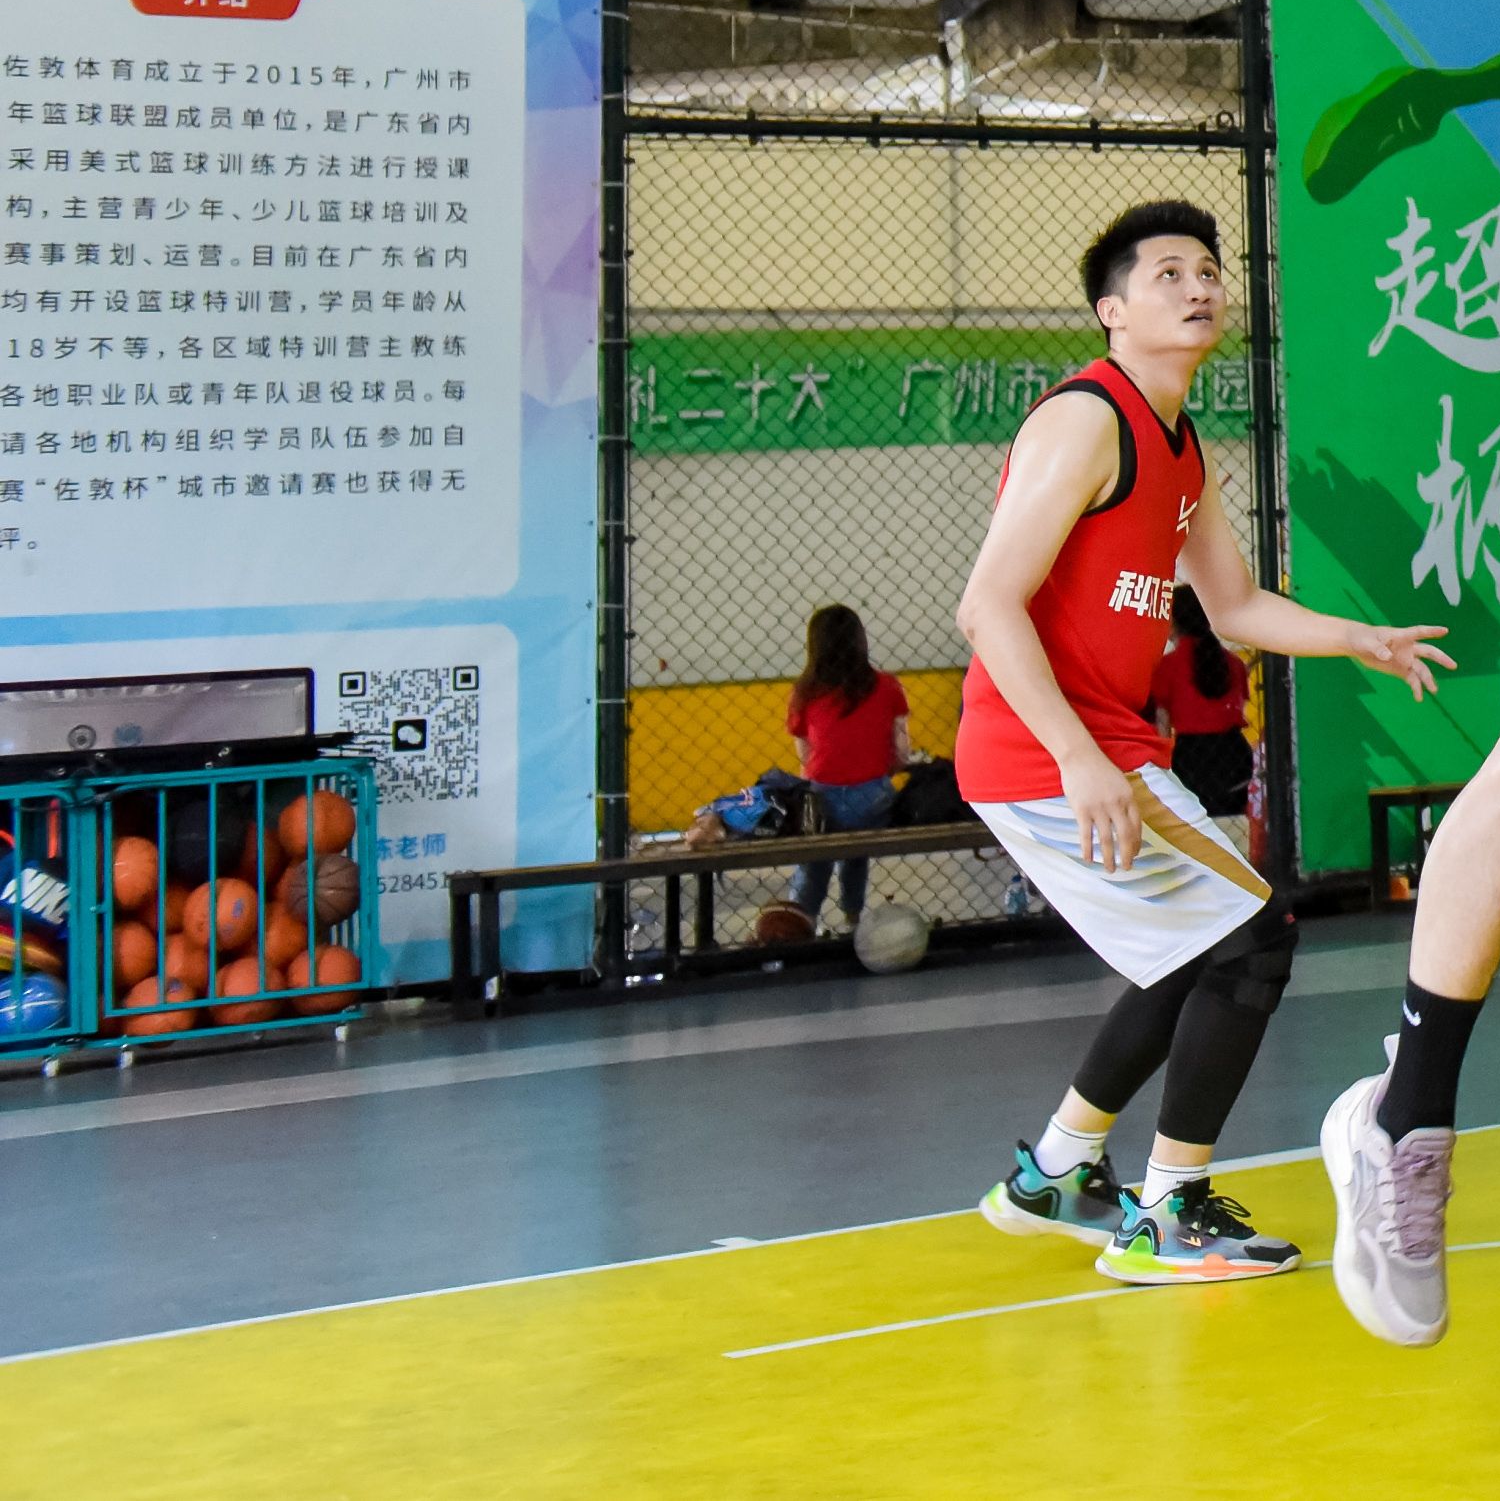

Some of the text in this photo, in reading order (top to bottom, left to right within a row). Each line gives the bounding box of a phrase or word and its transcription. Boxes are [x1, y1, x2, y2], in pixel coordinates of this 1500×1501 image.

[7, 148, 470, 180] 采用美式篮球训练方法进行授课
[0, 423, 465, 456] 请各地机构组织学员队伍参加自
